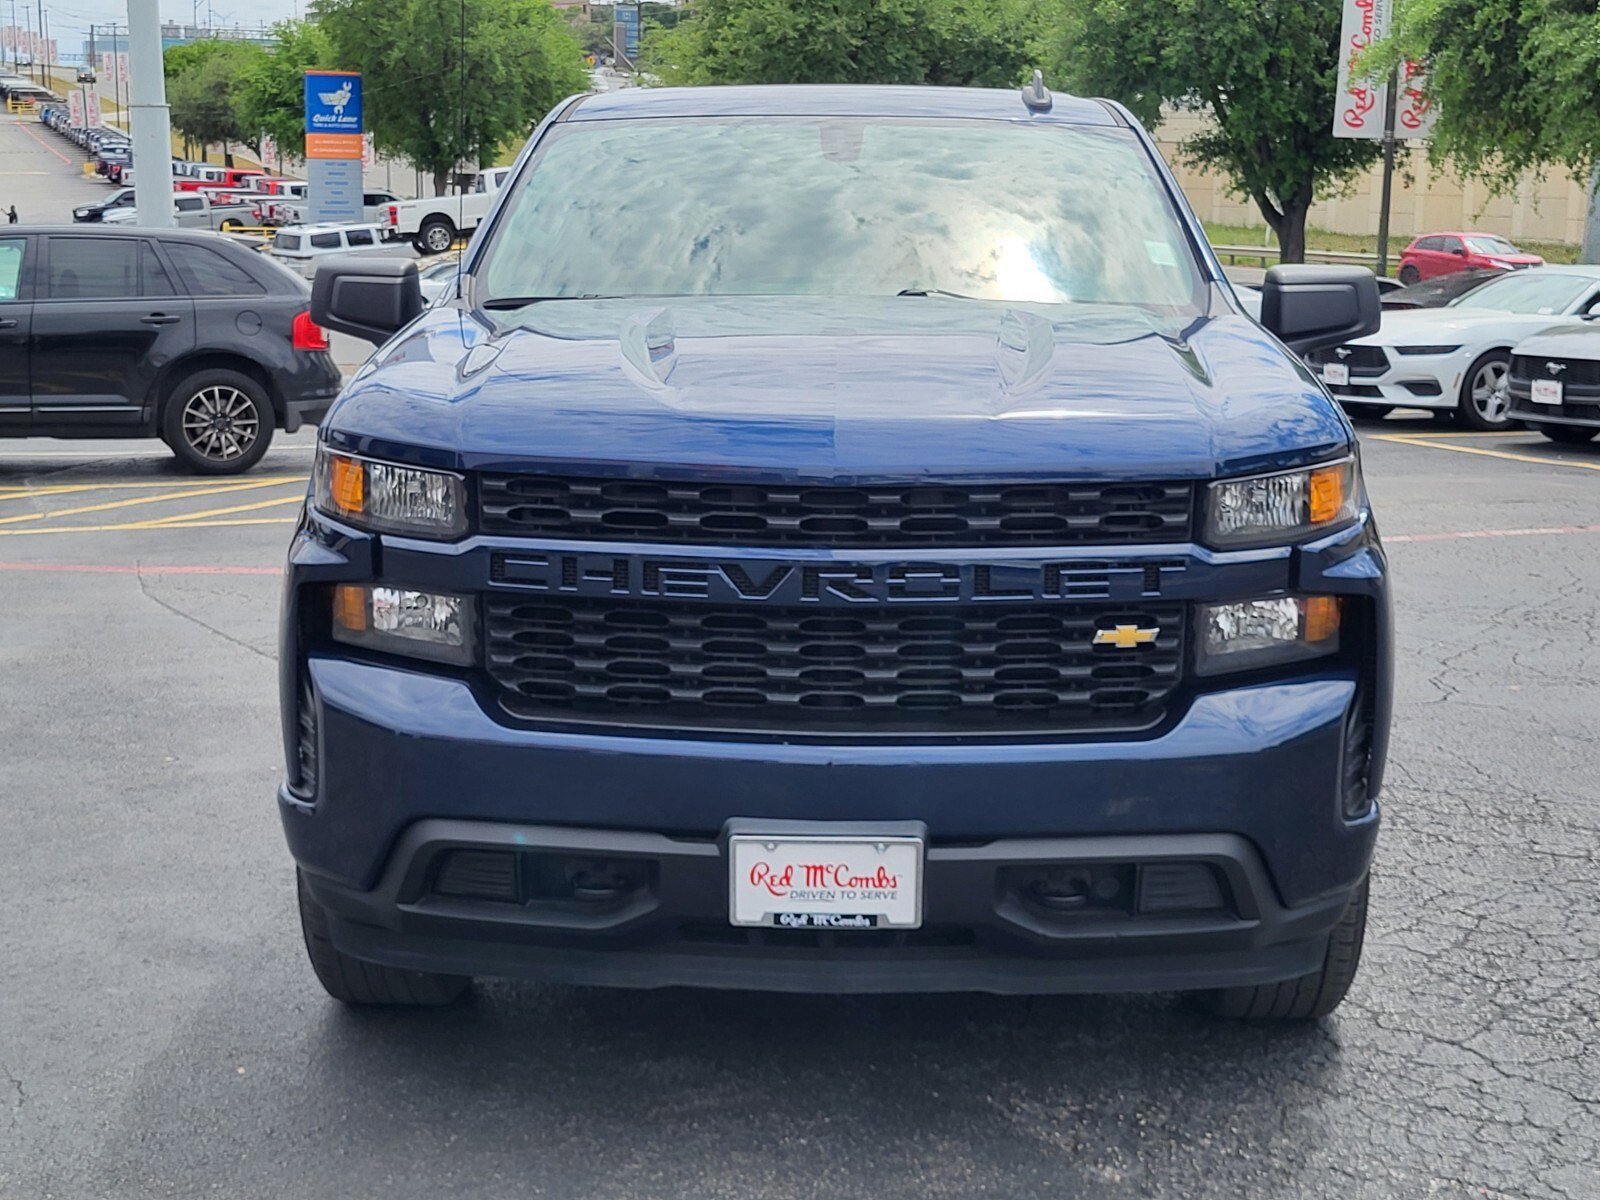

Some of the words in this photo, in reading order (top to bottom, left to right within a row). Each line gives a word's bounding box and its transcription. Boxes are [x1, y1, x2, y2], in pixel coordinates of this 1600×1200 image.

[312, 114, 337, 123] Quick
[338, 115, 358, 123] Lane
[1343, 87, 1375, 128] Red
[488, 552, 1188, 602] CHEVROLET
[750, 862, 794, 896] Red
[798, 864, 897, 888] McCombs
[790, 890, 835, 900] DRIVEN
[840, 890, 857, 900] TO
[861, 890, 897, 900] SERVE
[779, 914, 808, 927] Red
[810, 914, 871, 927] McCombs
